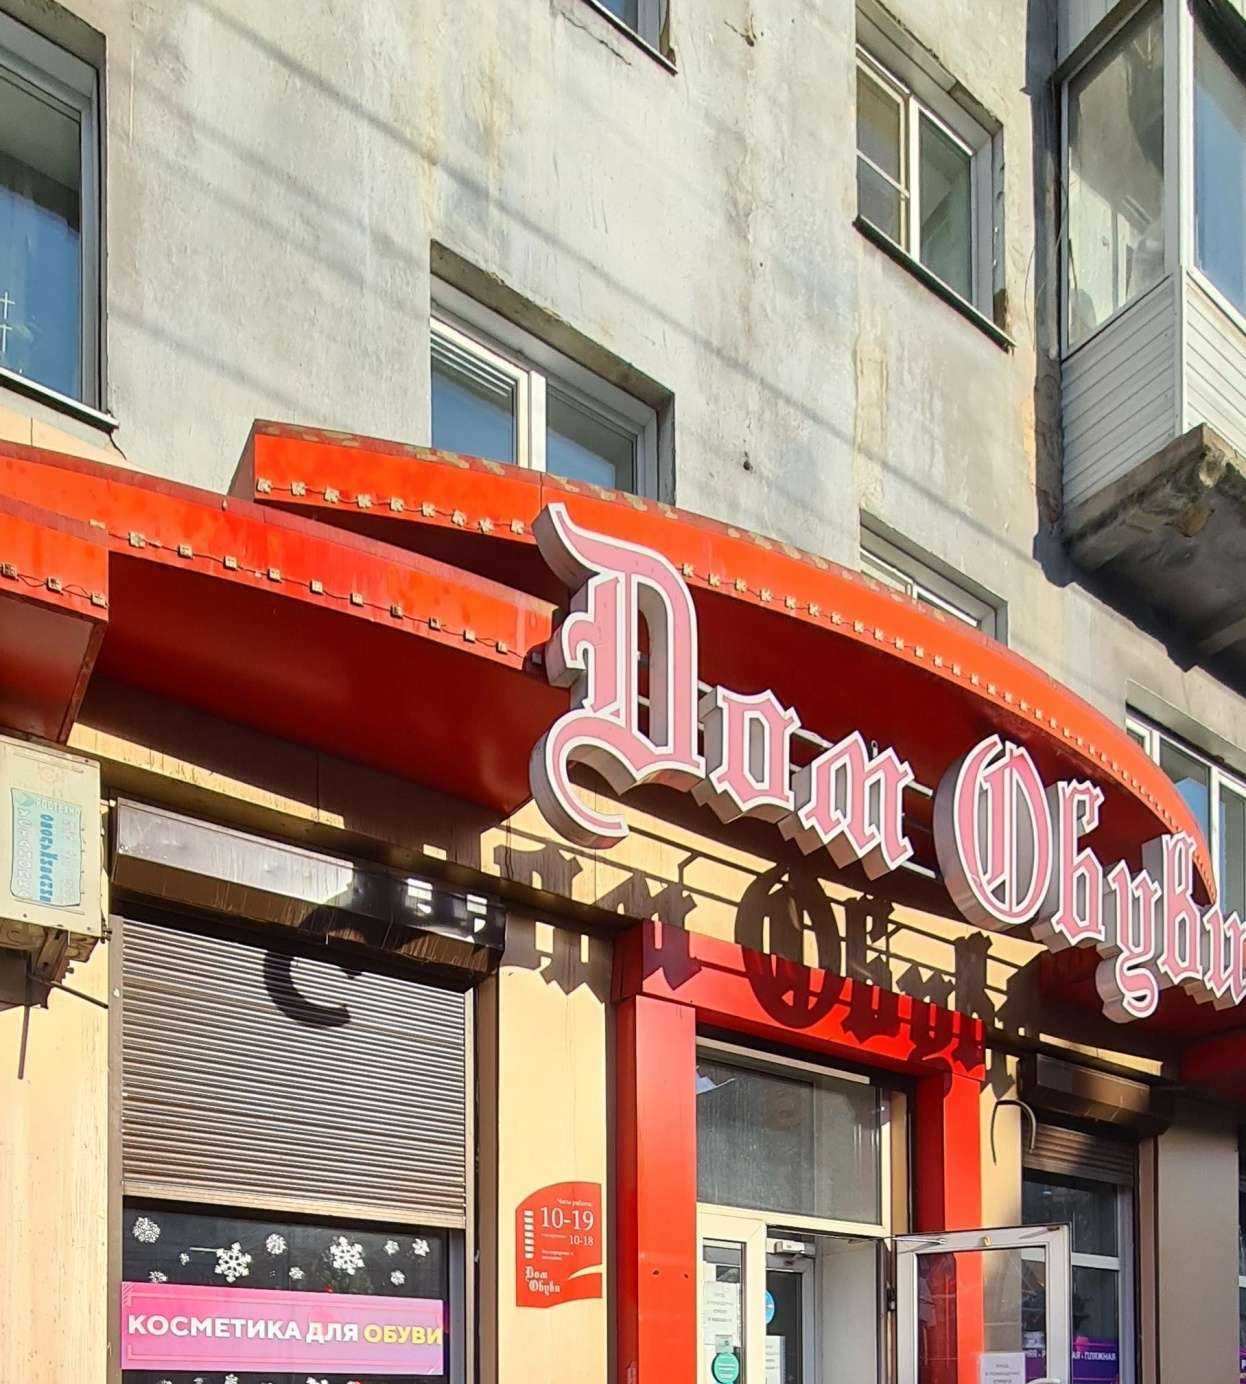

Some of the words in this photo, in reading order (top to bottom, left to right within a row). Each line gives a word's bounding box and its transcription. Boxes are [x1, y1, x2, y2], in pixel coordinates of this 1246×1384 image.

[545, 502, 914, 870] Дом
[954, 734, 1246, 1018] Обуви
[541, 1206, 594, 1231] 10-19
[128, 1315, 301, 1340] КОСМЕТИКА
[306, 1322, 358, 1343] ДЛЯ
[364, 1324, 443, 1345] ОБУВИ
